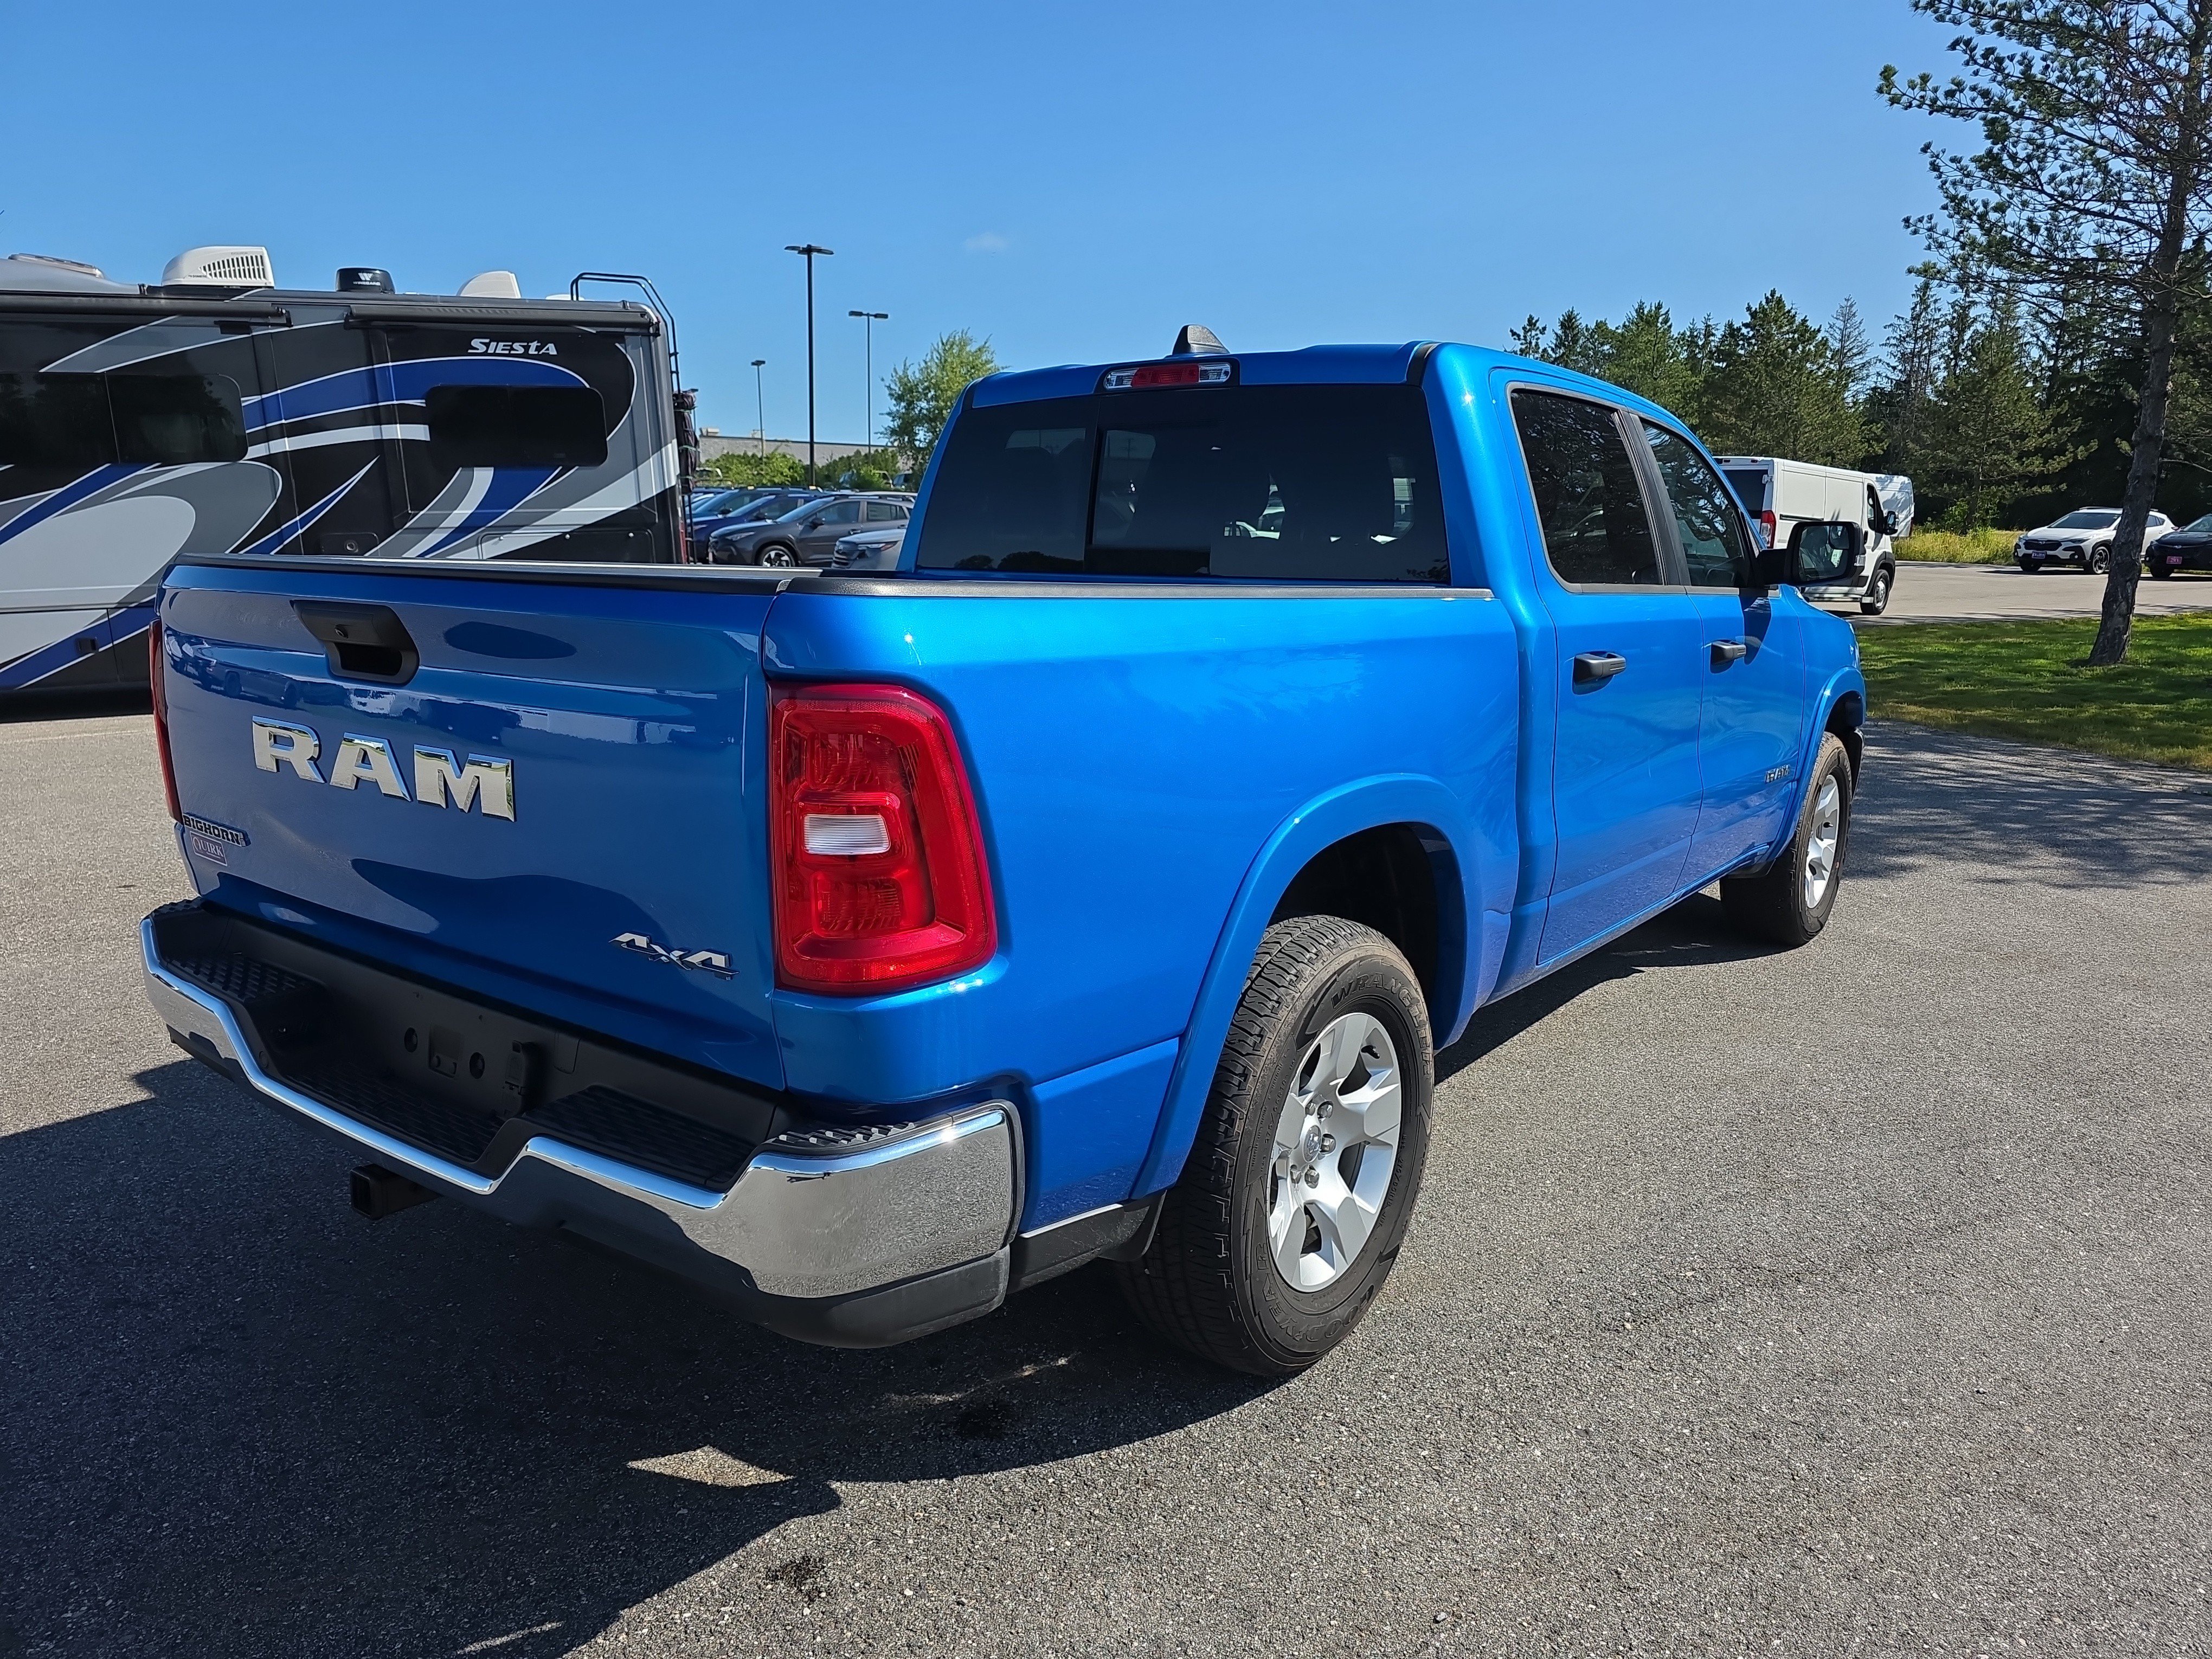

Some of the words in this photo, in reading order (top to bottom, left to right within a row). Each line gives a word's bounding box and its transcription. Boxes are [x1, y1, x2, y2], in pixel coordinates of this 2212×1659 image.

[252, 715, 516, 822] RAM
[182, 813, 242, 847] BIGHORN
[192, 837, 224, 857] QUIRK
[1330, 973, 1432, 1076] WRANGLER
[1255, 1242, 1375, 1343] GOODYEAR
